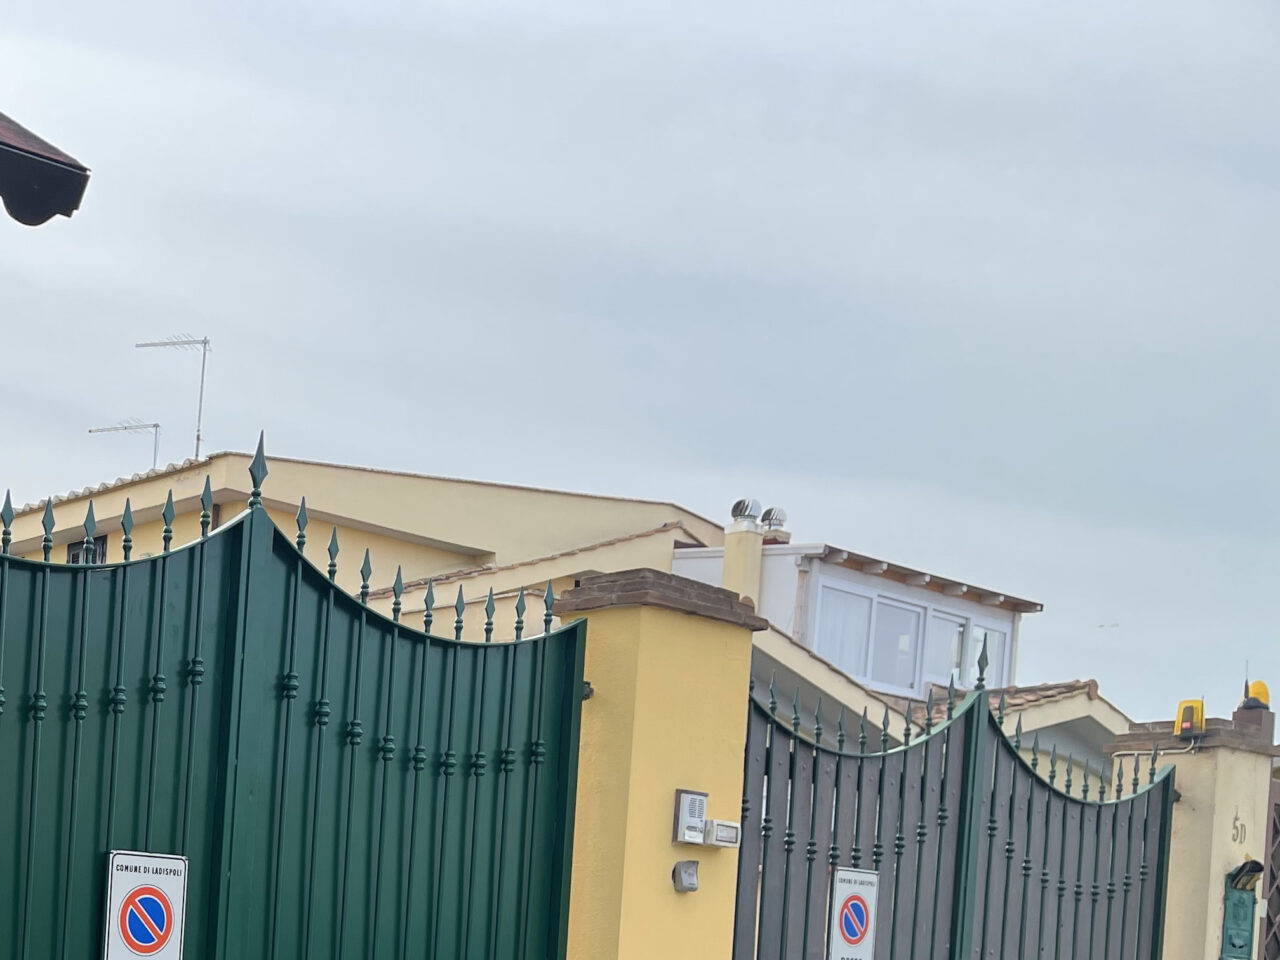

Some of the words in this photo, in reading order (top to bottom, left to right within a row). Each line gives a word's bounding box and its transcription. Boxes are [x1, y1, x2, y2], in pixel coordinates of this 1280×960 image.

[116, 864, 142, 873] COMUNE
[143, 866, 150, 875] DI
[151, 867, 182, 877] LADISPOLI
